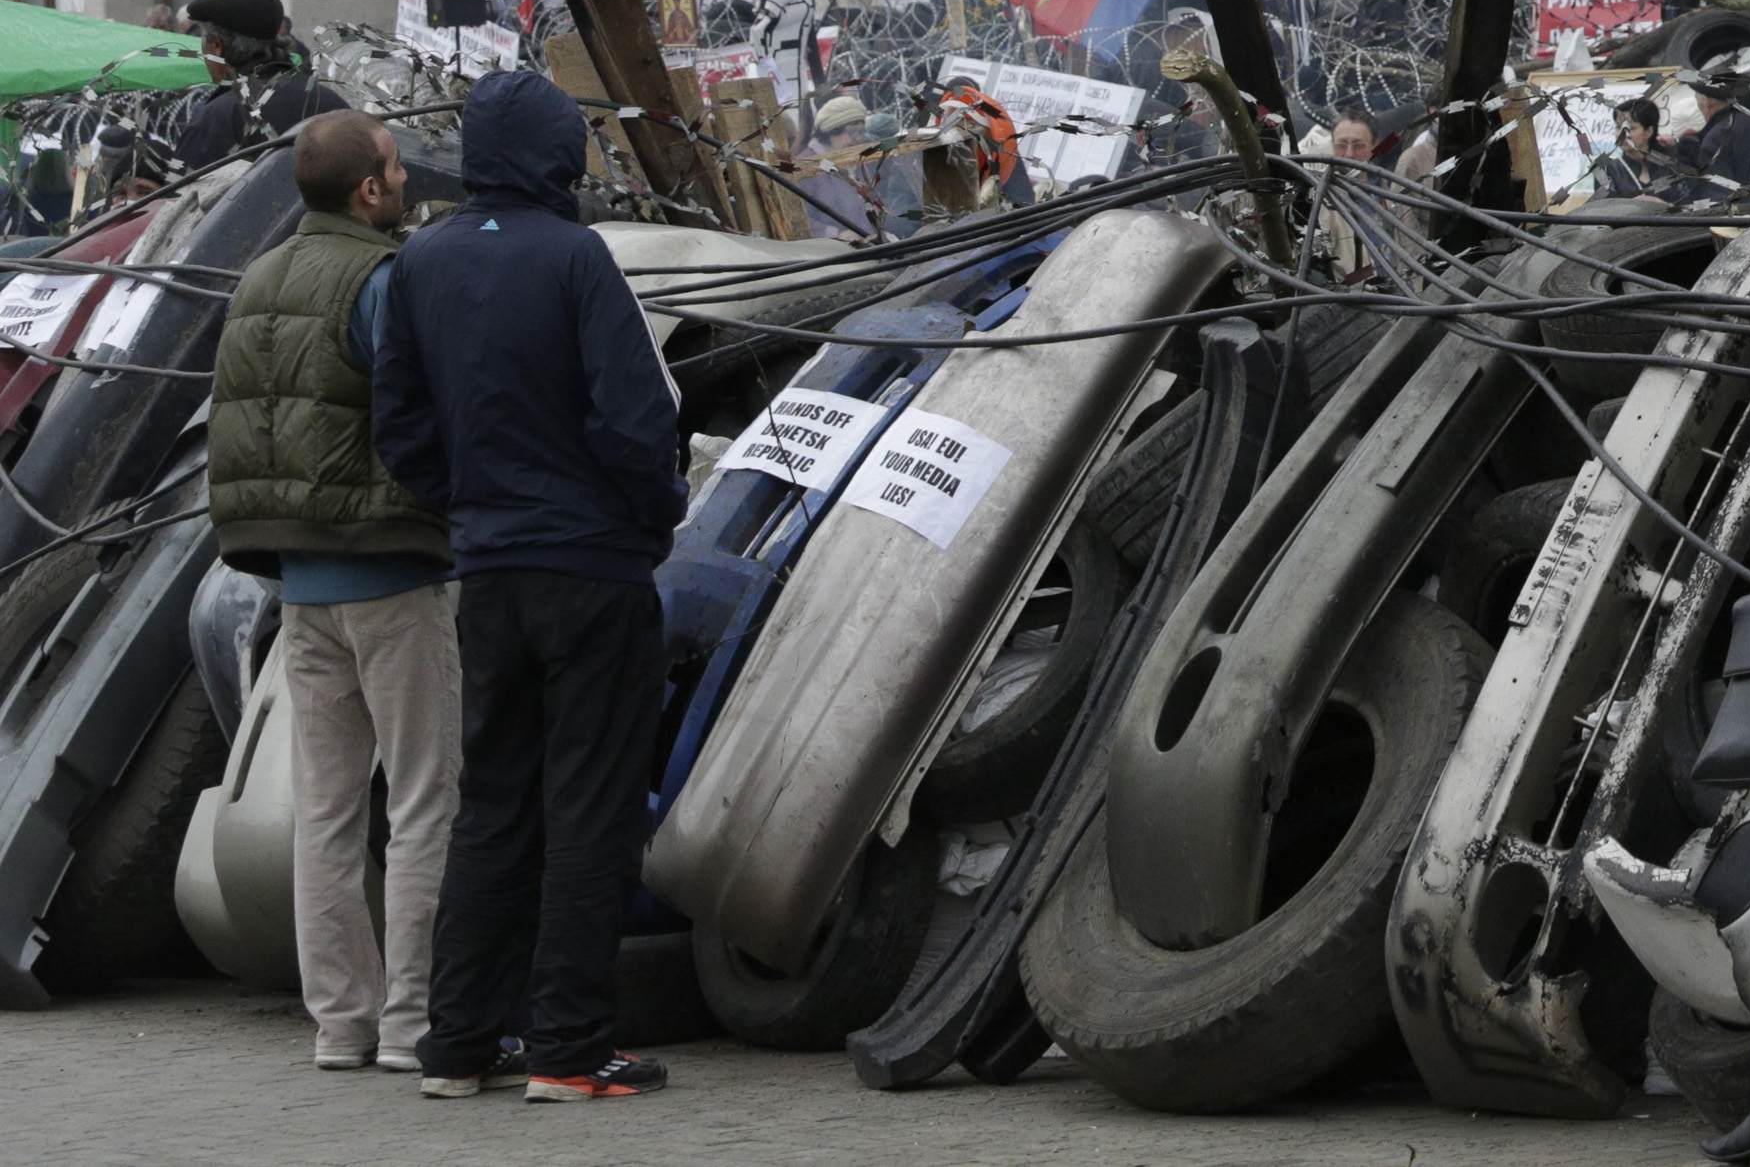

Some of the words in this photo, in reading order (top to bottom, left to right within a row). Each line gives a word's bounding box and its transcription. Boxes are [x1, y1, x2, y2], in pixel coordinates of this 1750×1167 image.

[773, 401, 824, 422] HANDS
[822, 409, 854, 429] OFF
[760, 423, 832, 451] DONETSK
[907, 428, 938, 450] USA!
[935, 437, 969, 464] EU!
[741, 443, 816, 474] REPUBLIC
[880, 450, 916, 476] YOUR
[909, 460, 962, 498] MEDIA
[880, 482, 916, 507] LIES!
